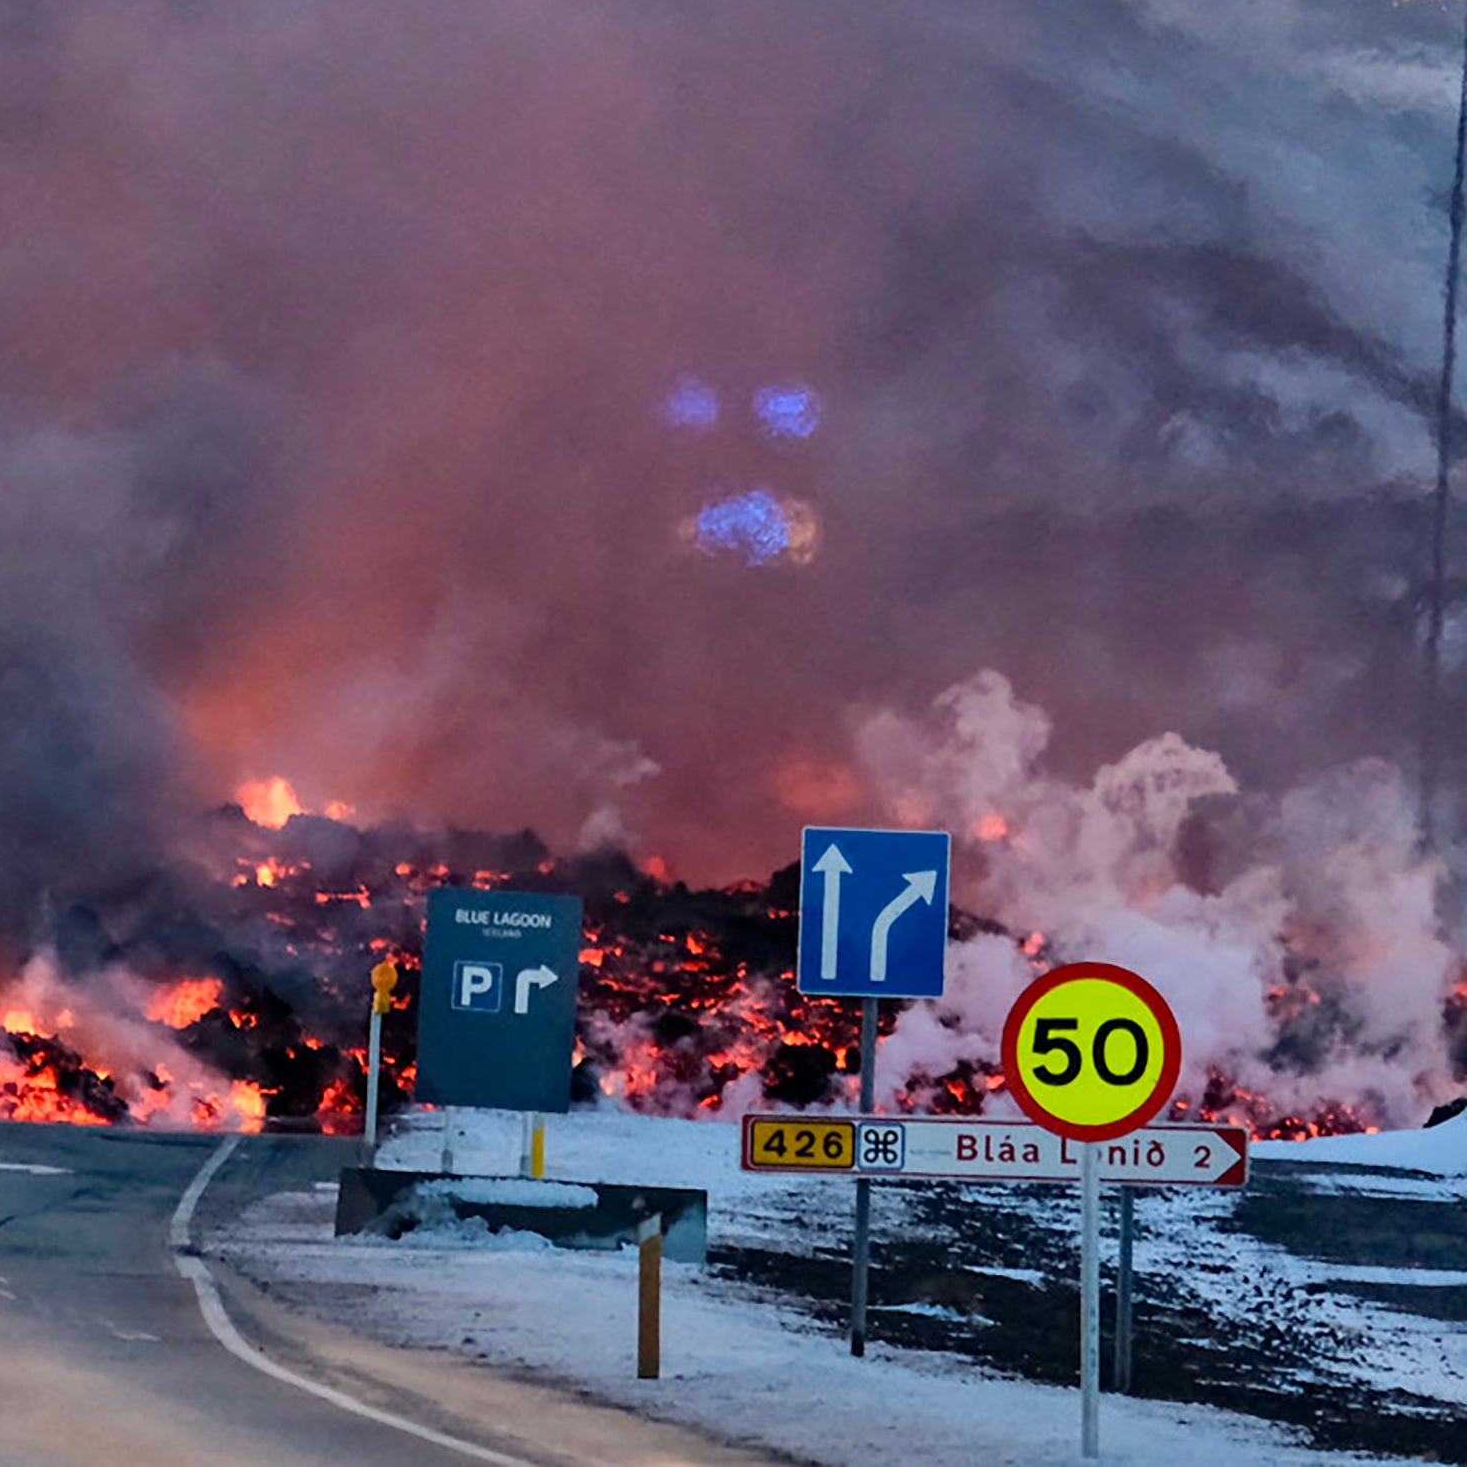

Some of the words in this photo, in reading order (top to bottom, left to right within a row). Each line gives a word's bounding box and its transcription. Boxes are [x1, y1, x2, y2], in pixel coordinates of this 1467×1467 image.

[455, 908, 490, 925] BLUE
[493, 911, 552, 928] LAGOON
[461, 966, 492, 1006] P
[1032, 1017, 1149, 1086] 50
[763, 1130, 843, 1159] 426
[956, 1134, 1040, 1162] Bláa
[1061, 1137, 1165, 1167] Lnið
[1194, 1145, 1211, 1168] 2
